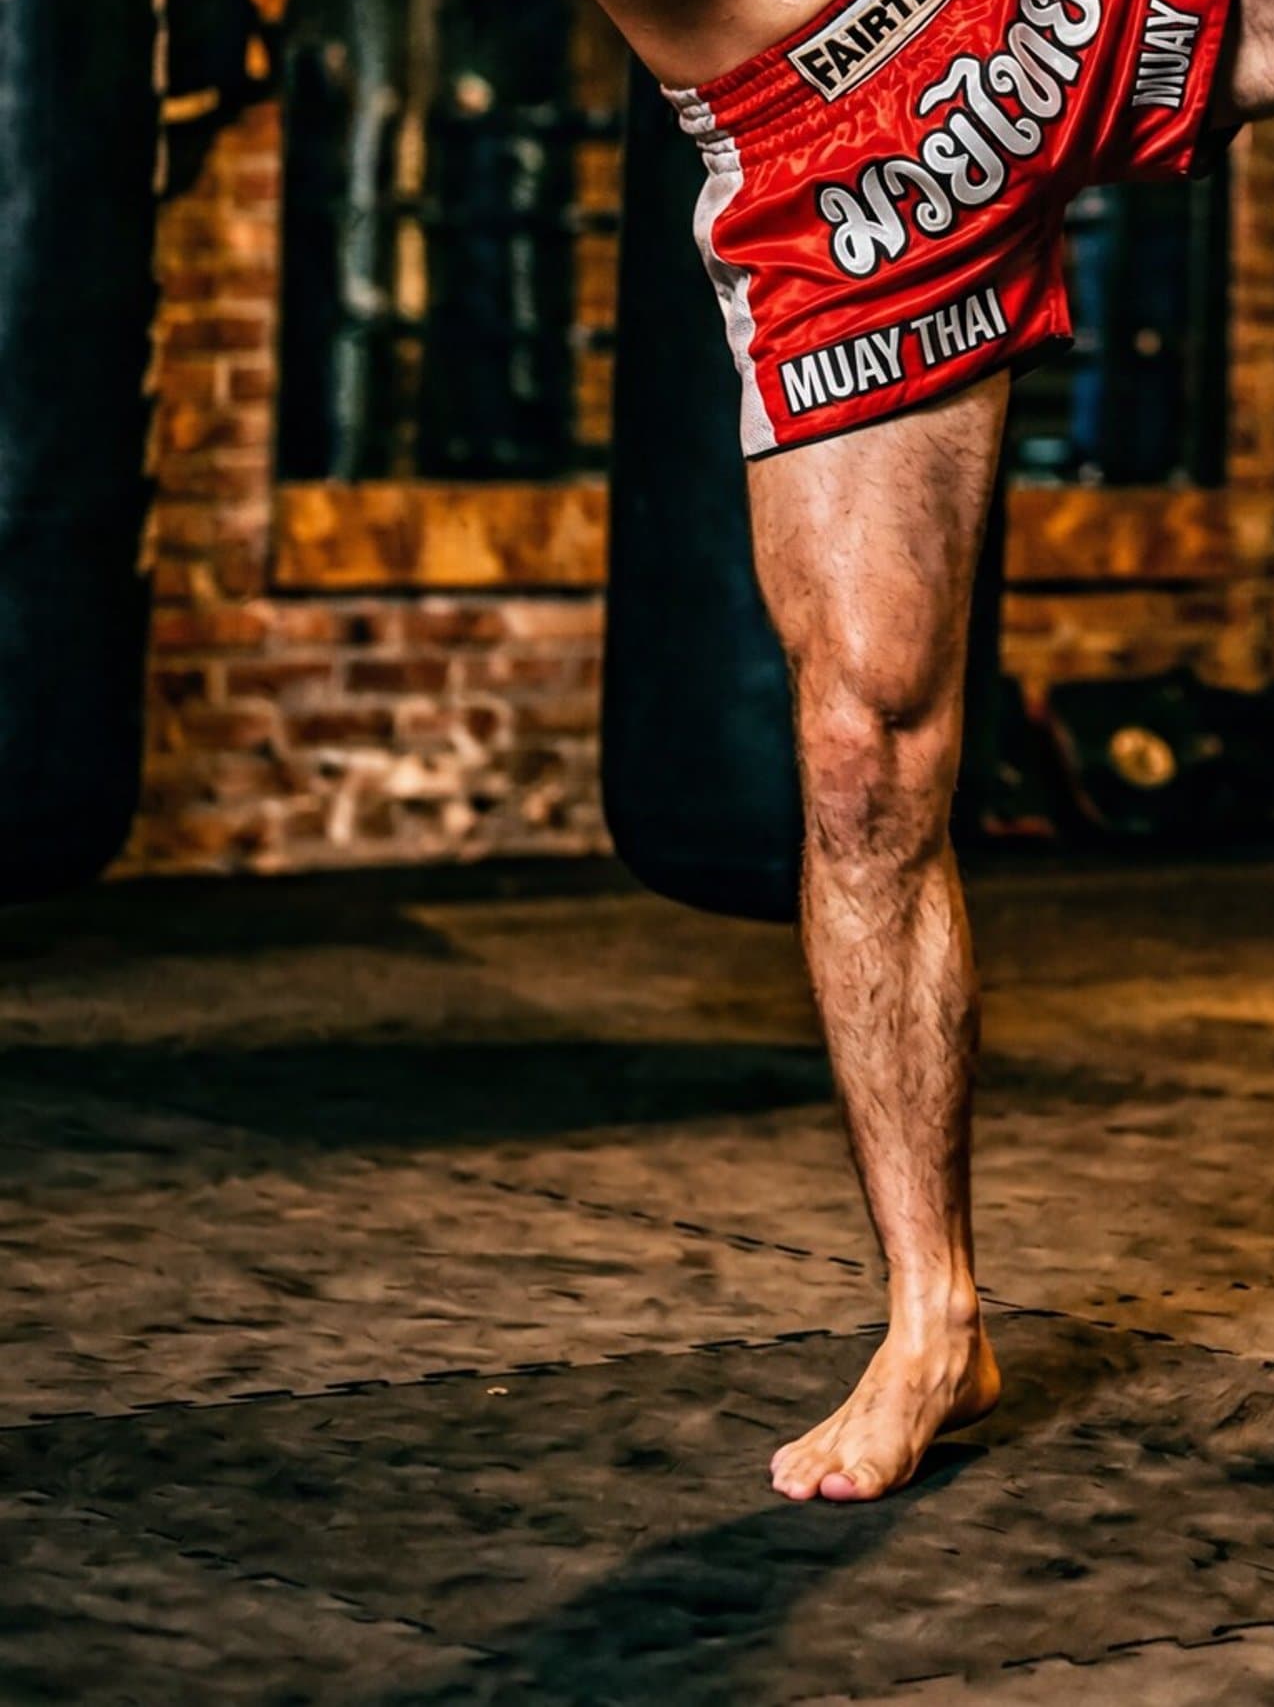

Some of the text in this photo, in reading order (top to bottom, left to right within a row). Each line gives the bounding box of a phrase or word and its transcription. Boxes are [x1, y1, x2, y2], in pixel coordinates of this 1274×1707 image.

[1132, 0, 1200, 107] MUAY
[781, 288, 1008, 411] MUAY THAI
